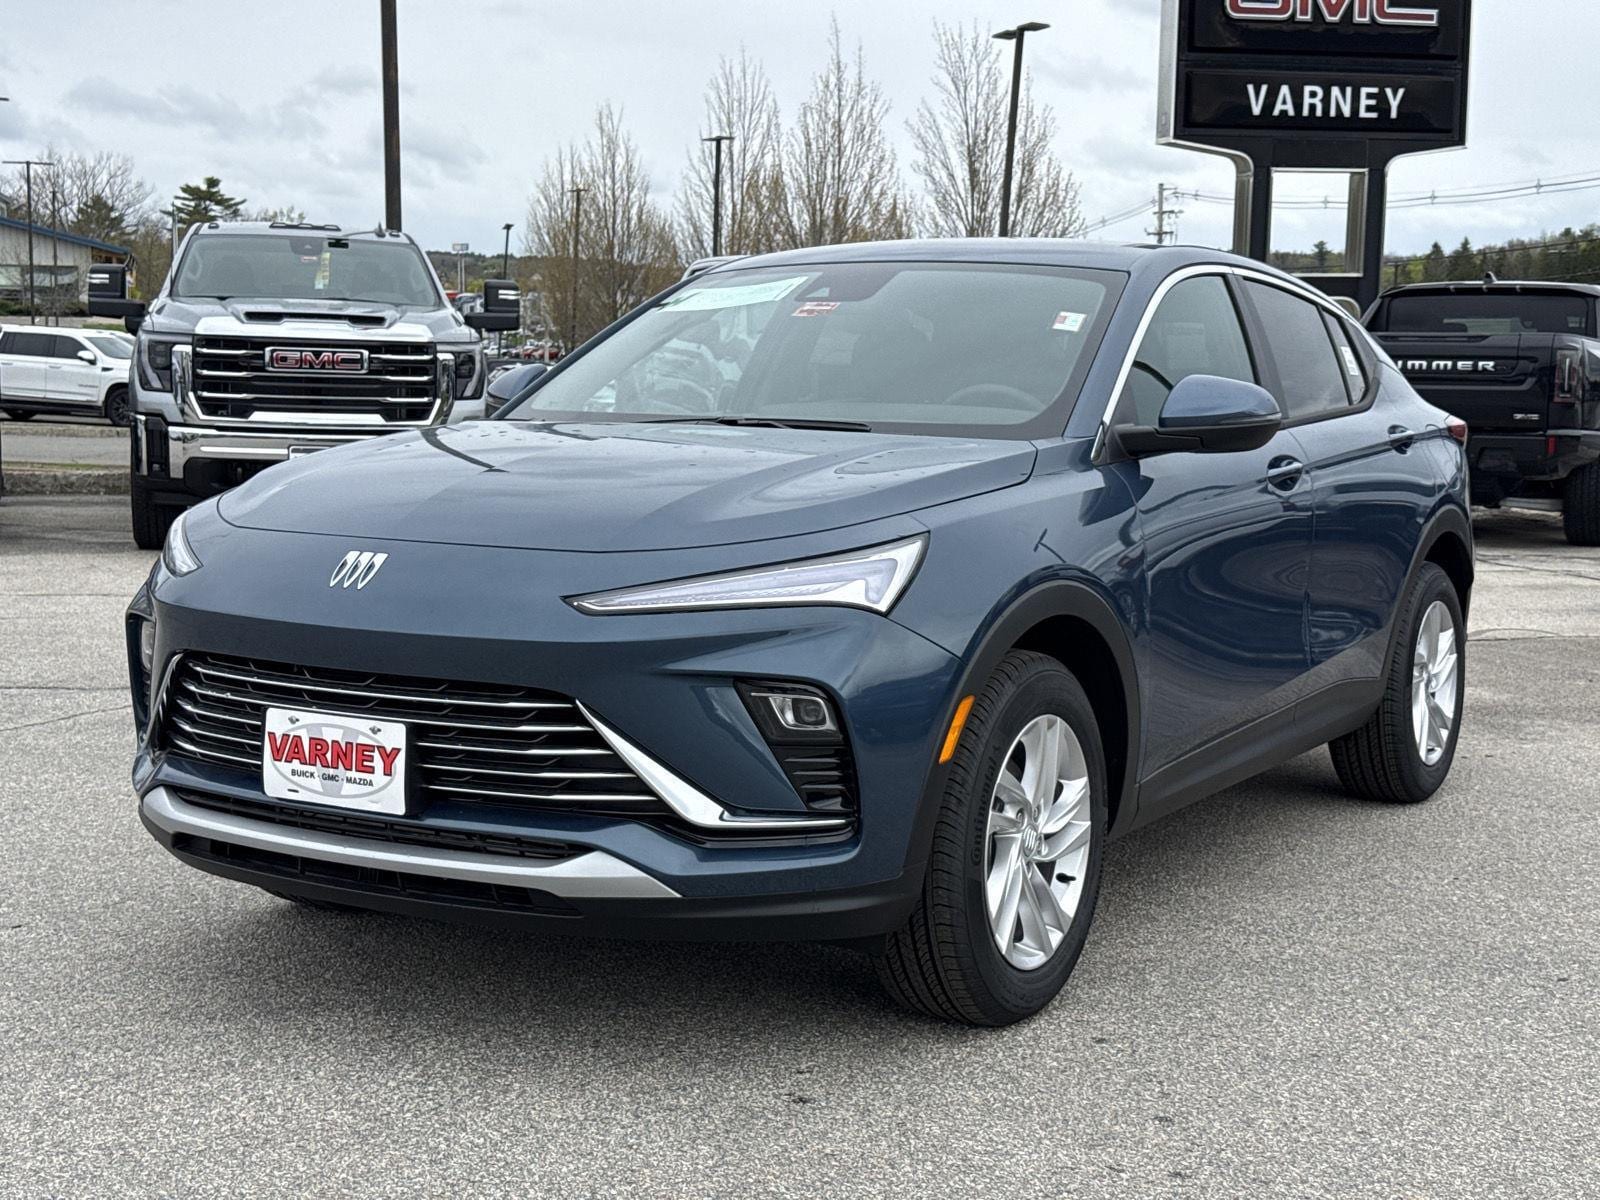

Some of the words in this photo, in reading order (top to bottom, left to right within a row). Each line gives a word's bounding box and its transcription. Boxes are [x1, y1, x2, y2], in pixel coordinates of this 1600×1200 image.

[1246, 83, 1406, 119] VARNEY
[273, 351, 361, 369] GMC
[267, 731, 402, 777] VARNEY
[291, 768, 315, 779] BUICK
[321, 773, 340, 782] GMC
[345, 776, 374, 787] MAZDA
